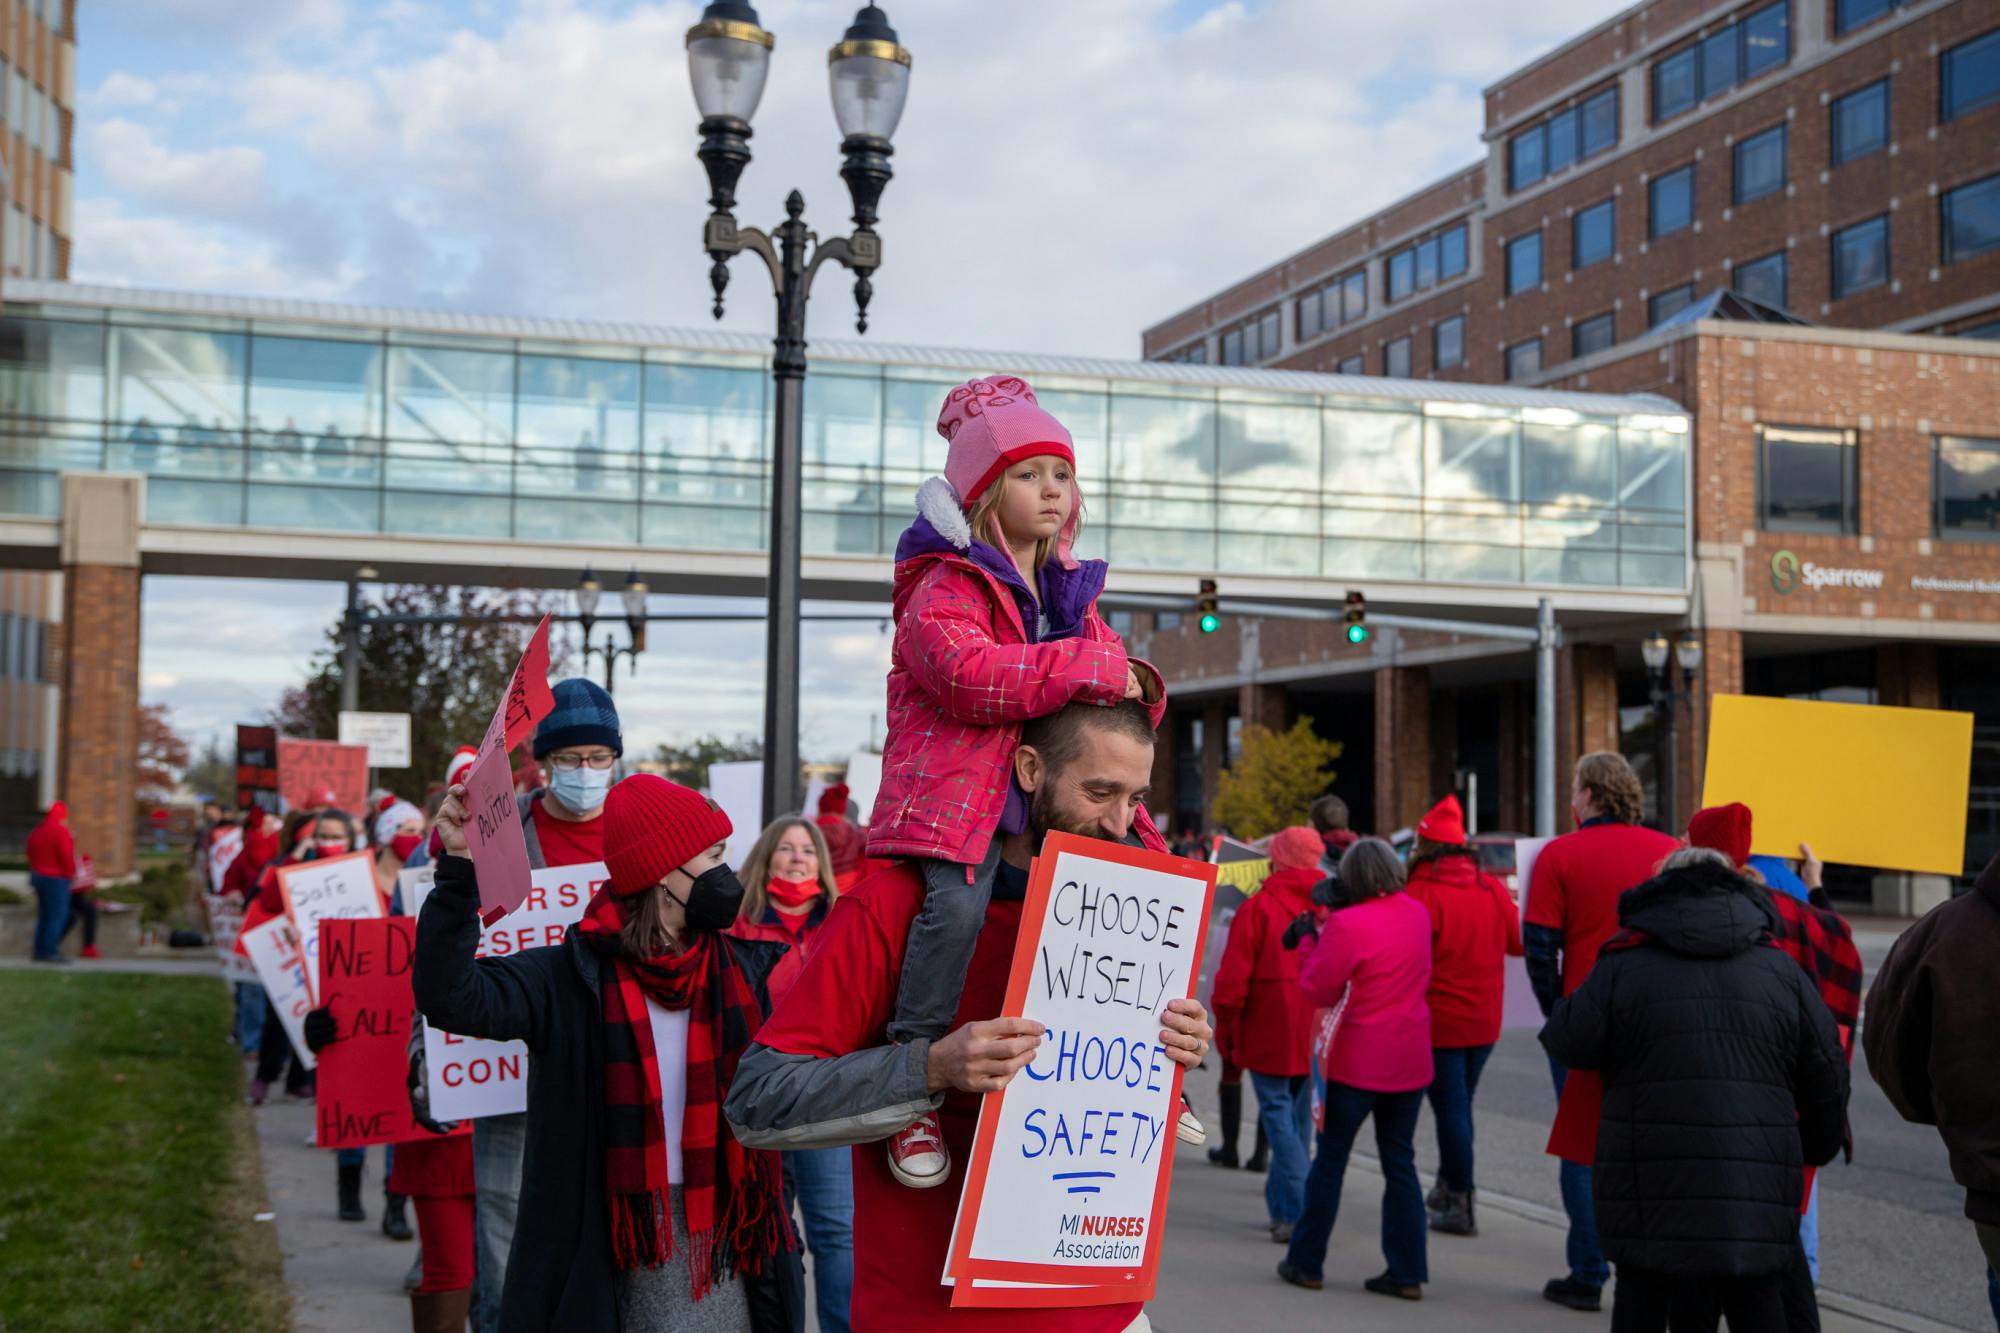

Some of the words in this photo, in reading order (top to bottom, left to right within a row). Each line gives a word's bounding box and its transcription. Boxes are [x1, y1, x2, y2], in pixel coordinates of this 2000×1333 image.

[1802, 562, 1883, 591] Sparrow
[1054, 881, 1184, 948] CHOOSE
[474, 924, 565, 959] ESER
[327, 992, 415, 1042] CALL-
[442, 1054, 528, 1088] CON
[1025, 1029, 1166, 1092] CHOOSE
[321, 1102, 396, 1145] HAVE
[1022, 1108, 1164, 1164] SAFETY
[1059, 1214, 1080, 1235] MI
[1081, 1215, 1144, 1237] NURSES
[1053, 1239, 1140, 1260] Association
